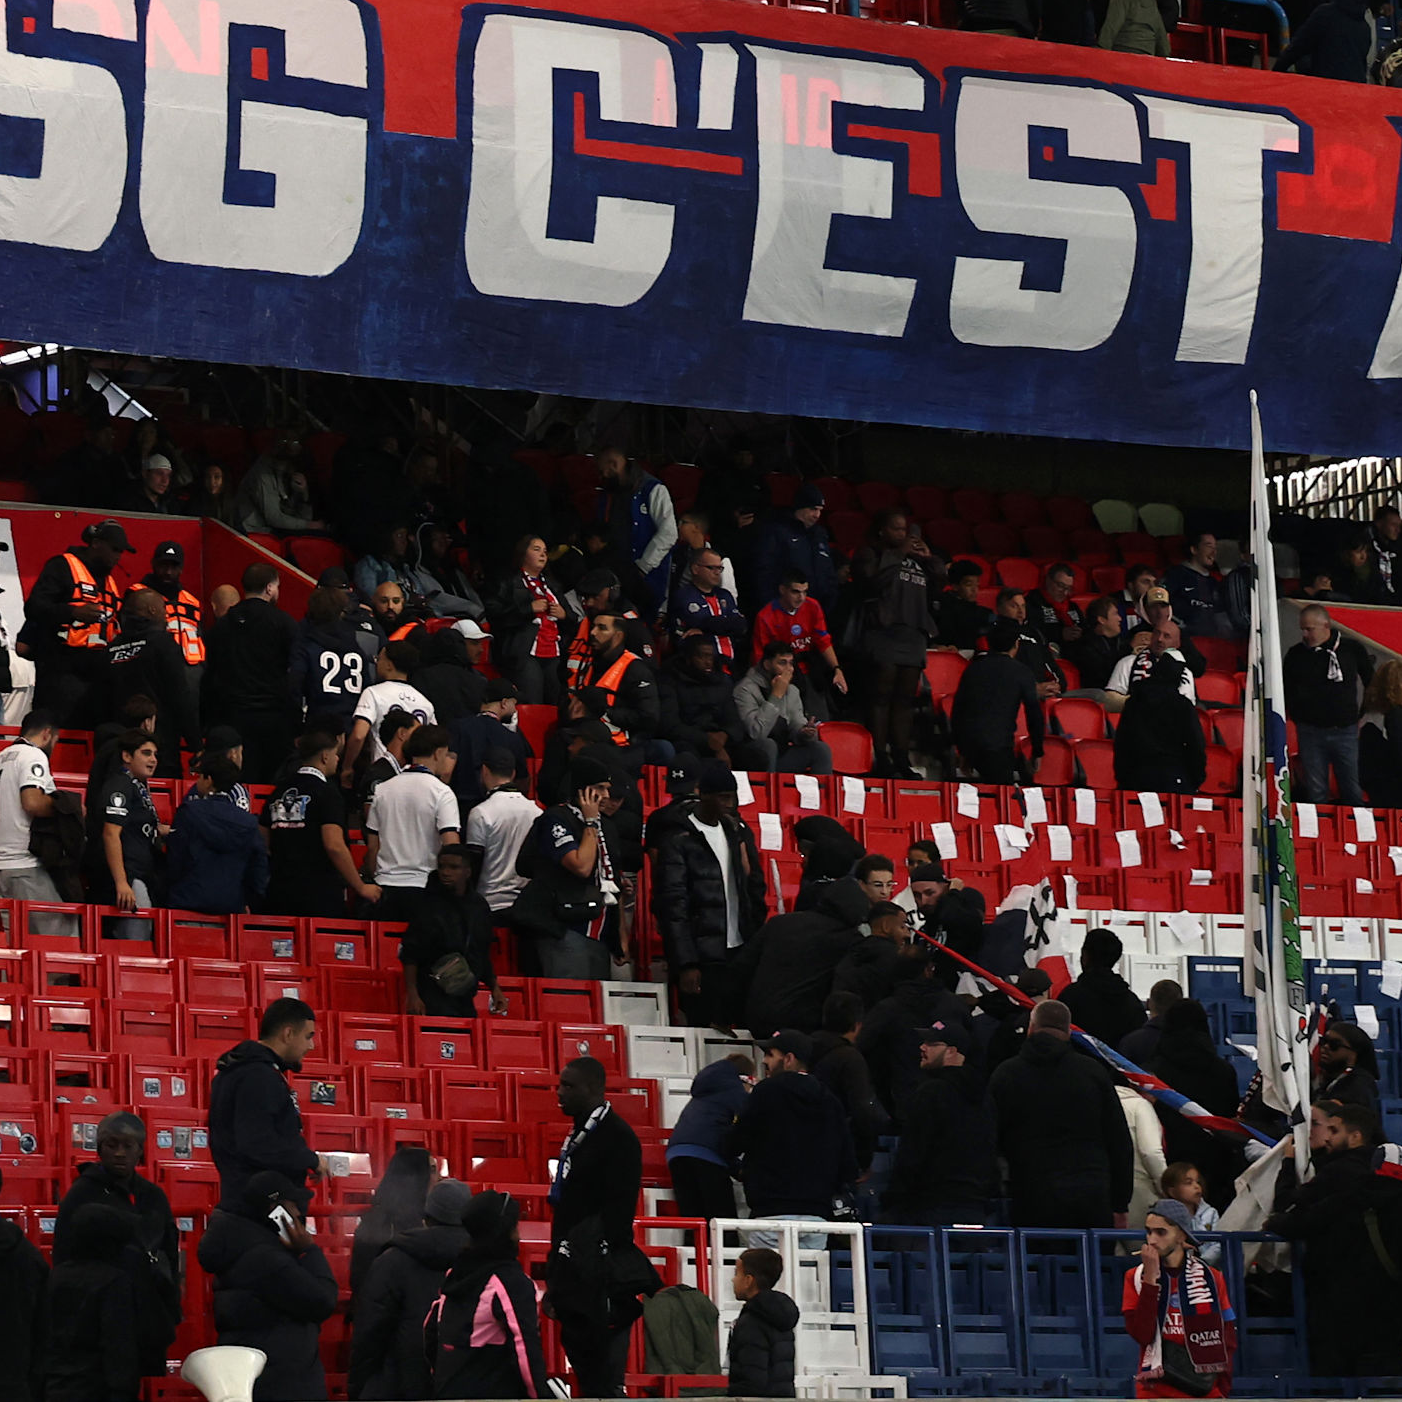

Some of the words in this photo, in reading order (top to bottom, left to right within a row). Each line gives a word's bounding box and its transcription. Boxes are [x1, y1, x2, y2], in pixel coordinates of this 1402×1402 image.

[465, 12, 1300, 365] C'EST
[319, 650, 364, 695] 23
[1190, 1330, 1220, 1344] QATAR
